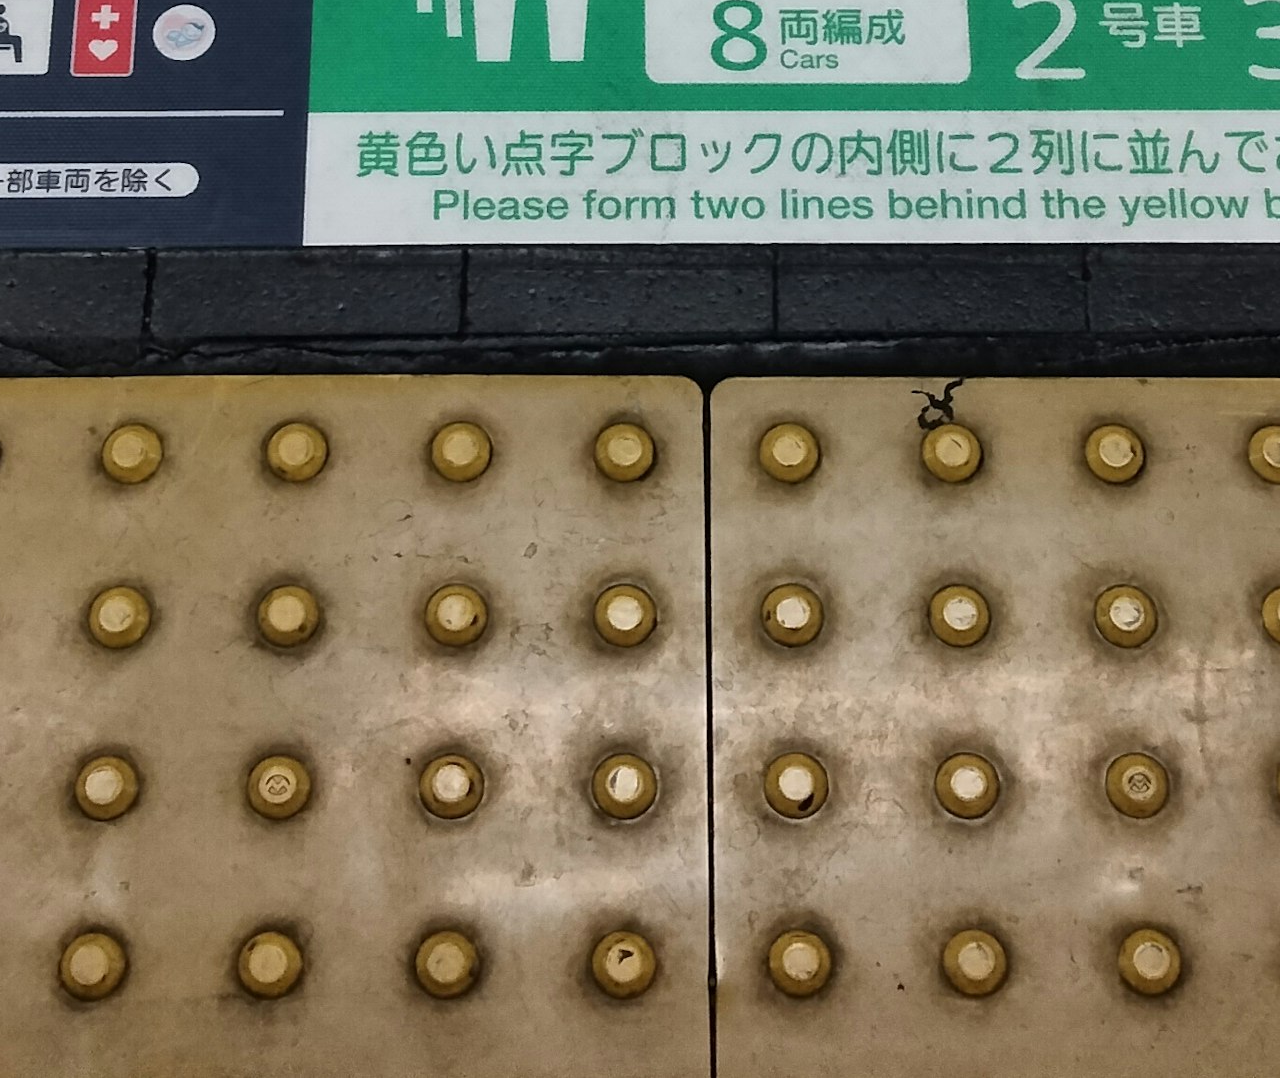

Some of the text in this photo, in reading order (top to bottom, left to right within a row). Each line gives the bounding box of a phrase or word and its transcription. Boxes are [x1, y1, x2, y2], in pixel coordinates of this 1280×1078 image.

[780, 49, 838, 69] Cars
[434, 190, 568, 220] Please
[583, 189, 675, 220] form
[691, 190, 765, 219] two
[781, 189, 873, 219] lines
[888, 189, 1026, 219] behind
[1041, 189, 1106, 219] the
[1119, 188, 1248, 226] yellow
